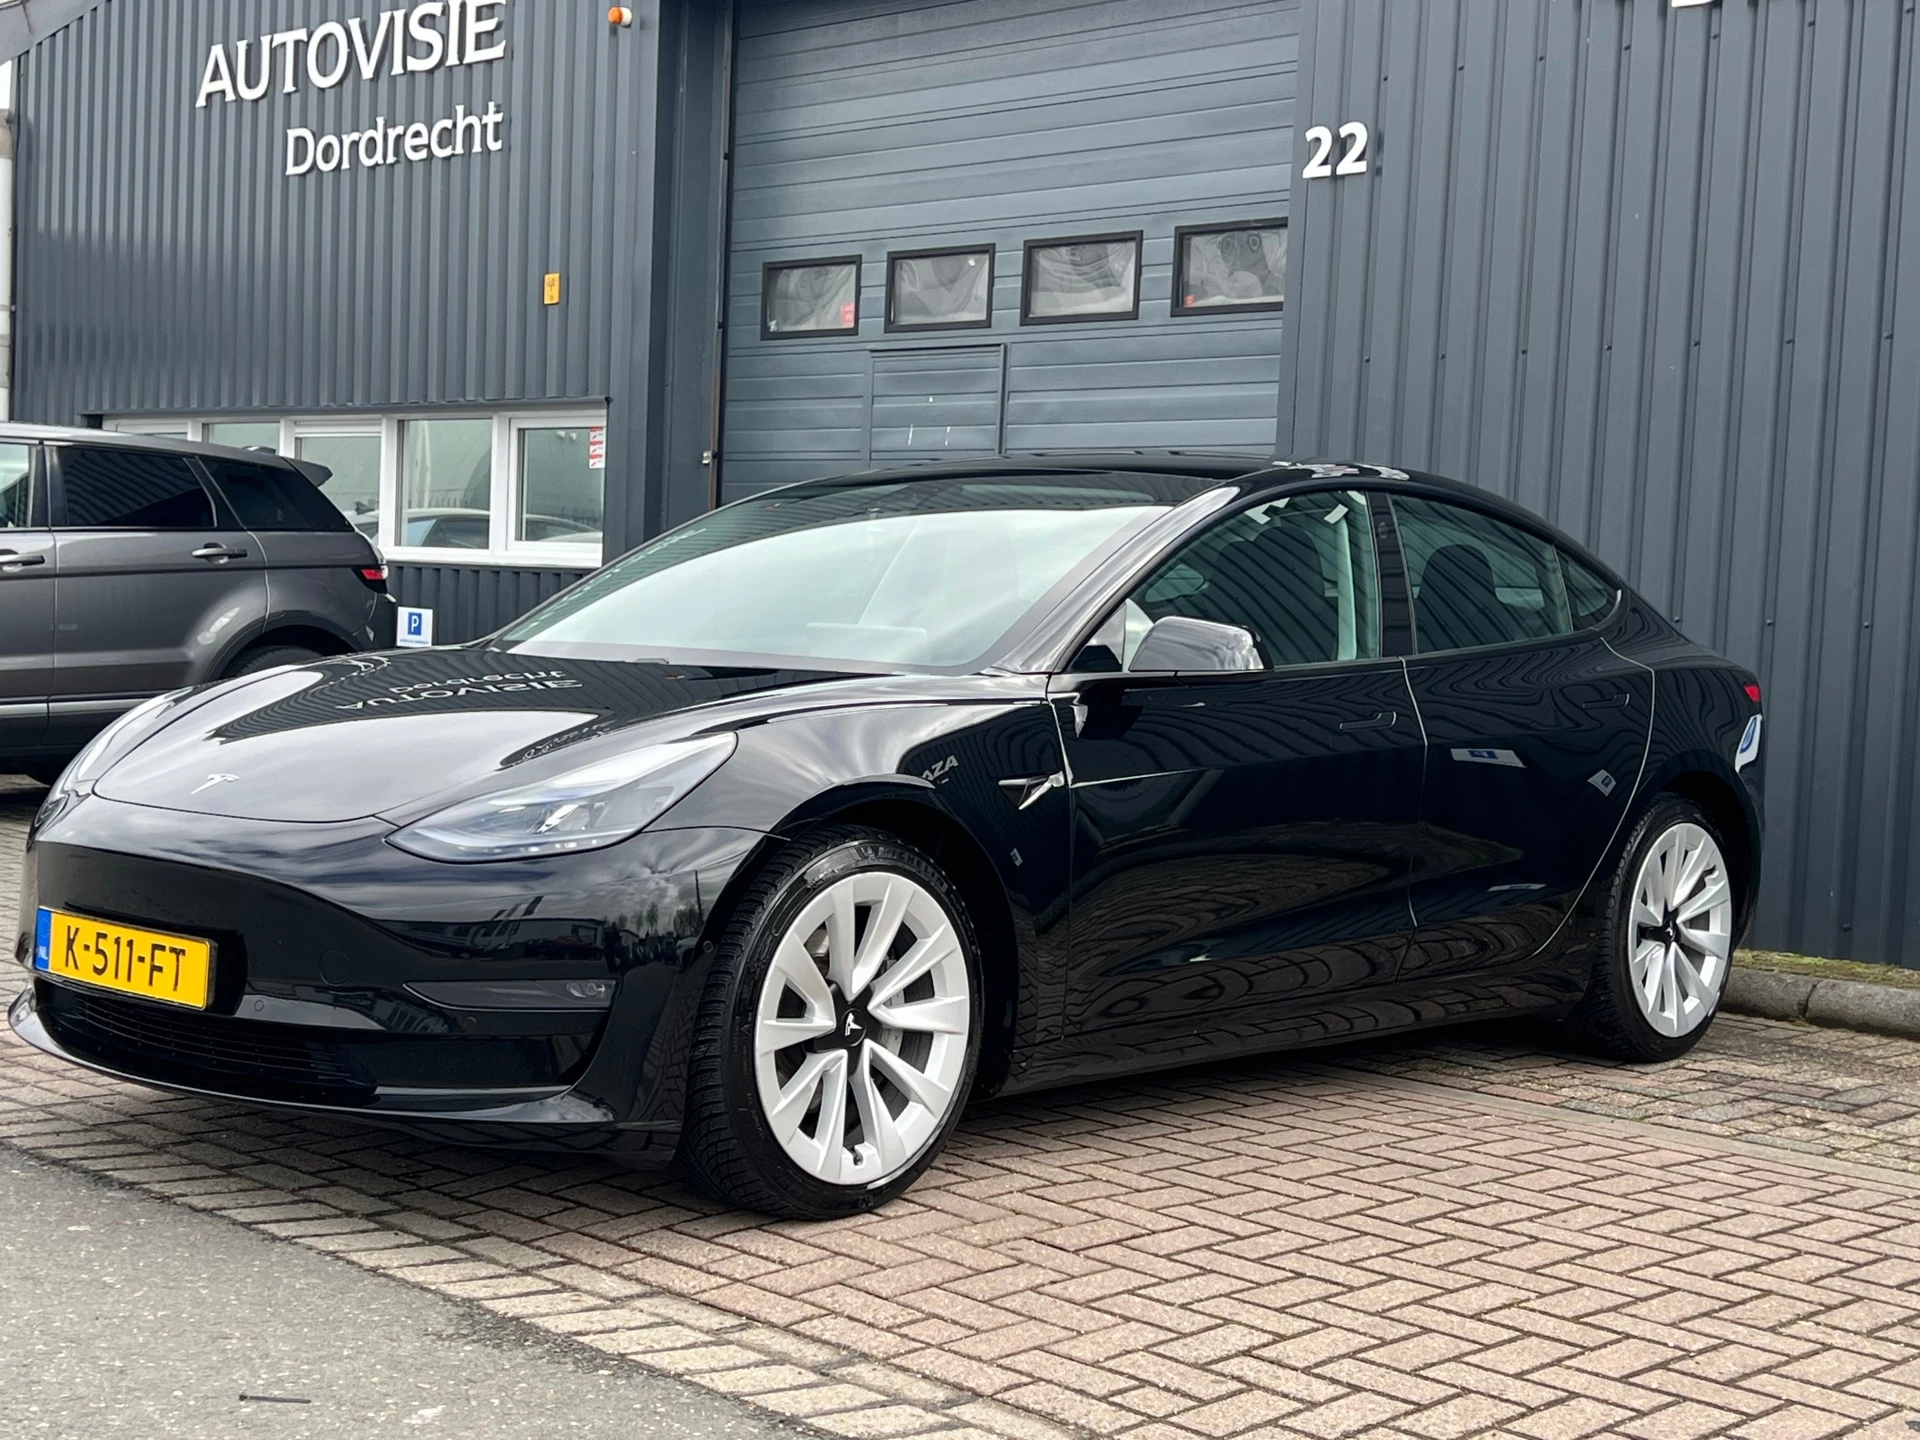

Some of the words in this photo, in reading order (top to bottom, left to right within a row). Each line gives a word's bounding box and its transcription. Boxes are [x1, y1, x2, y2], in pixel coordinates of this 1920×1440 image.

[195, 0, 507, 108] AUTOVISIE
[285, 101, 504, 176] Dordrecht
[1302, 121, 1368, 179] 22
[65, 924, 186, 992] K-511-FT
